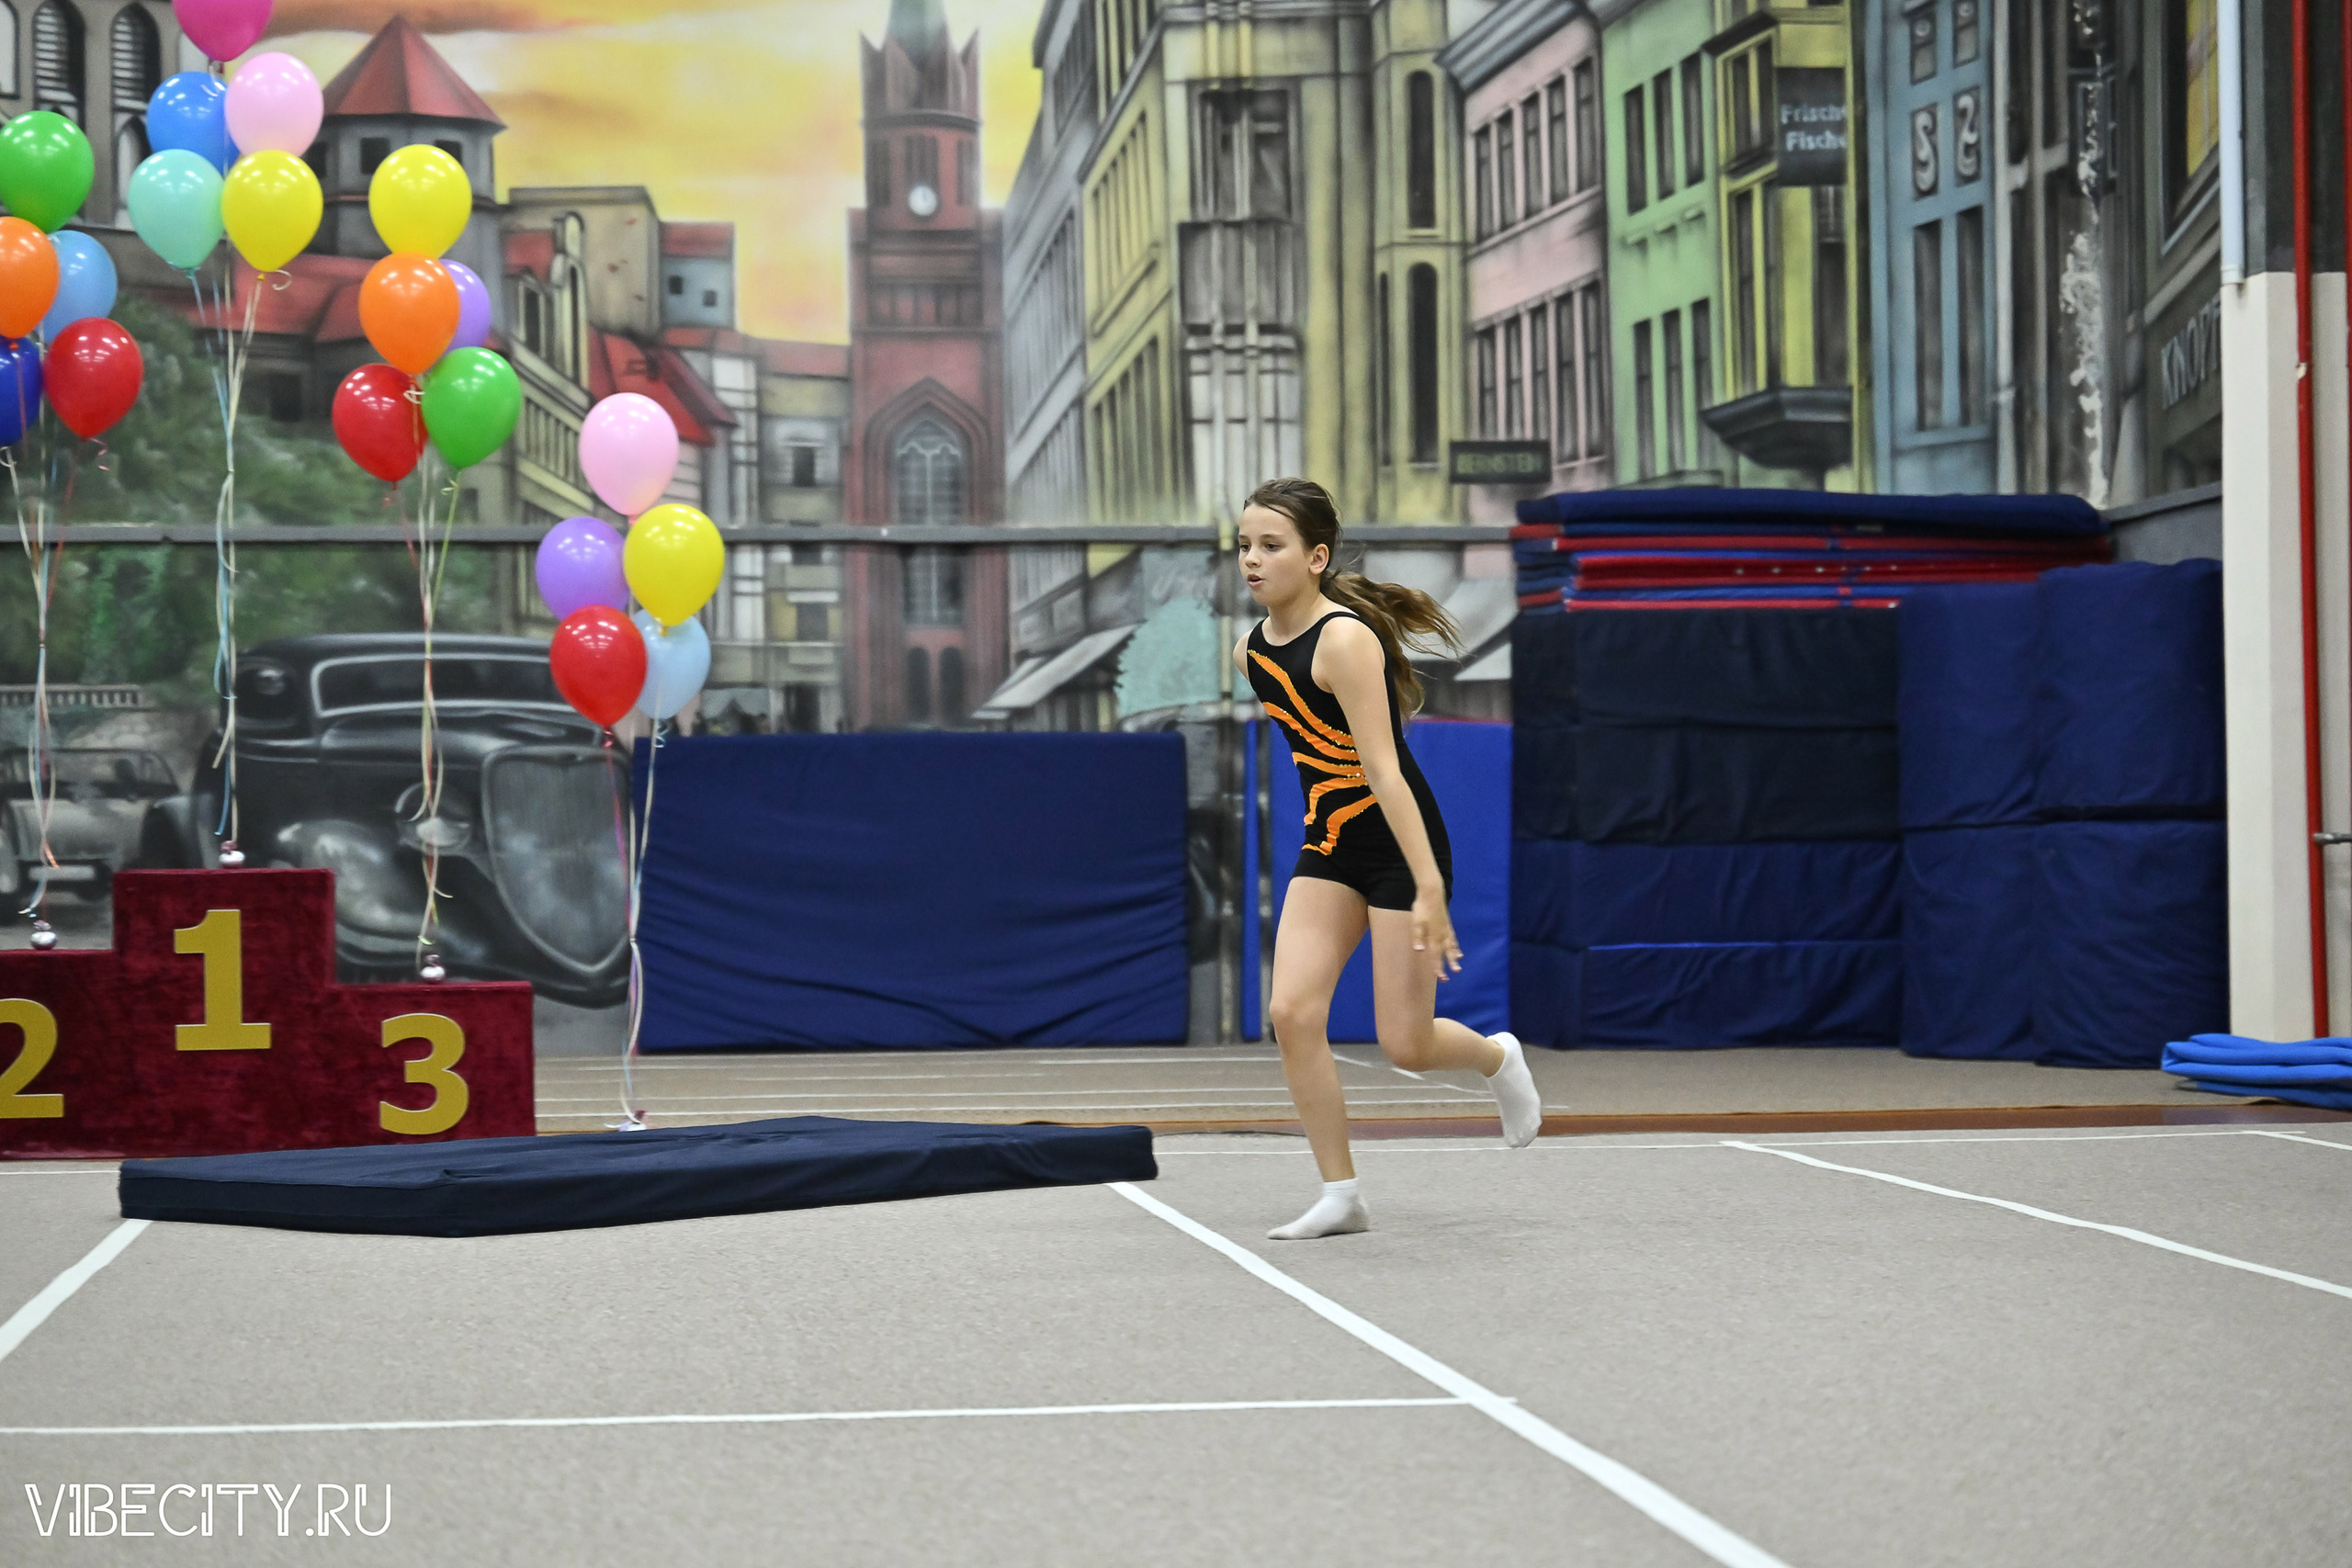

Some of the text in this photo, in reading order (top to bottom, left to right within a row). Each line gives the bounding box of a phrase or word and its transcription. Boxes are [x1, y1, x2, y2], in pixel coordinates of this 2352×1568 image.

[174, 909, 272, 1052] 1
[0, 998, 65, 1120] 2
[379, 1013, 469, 1135] 3
